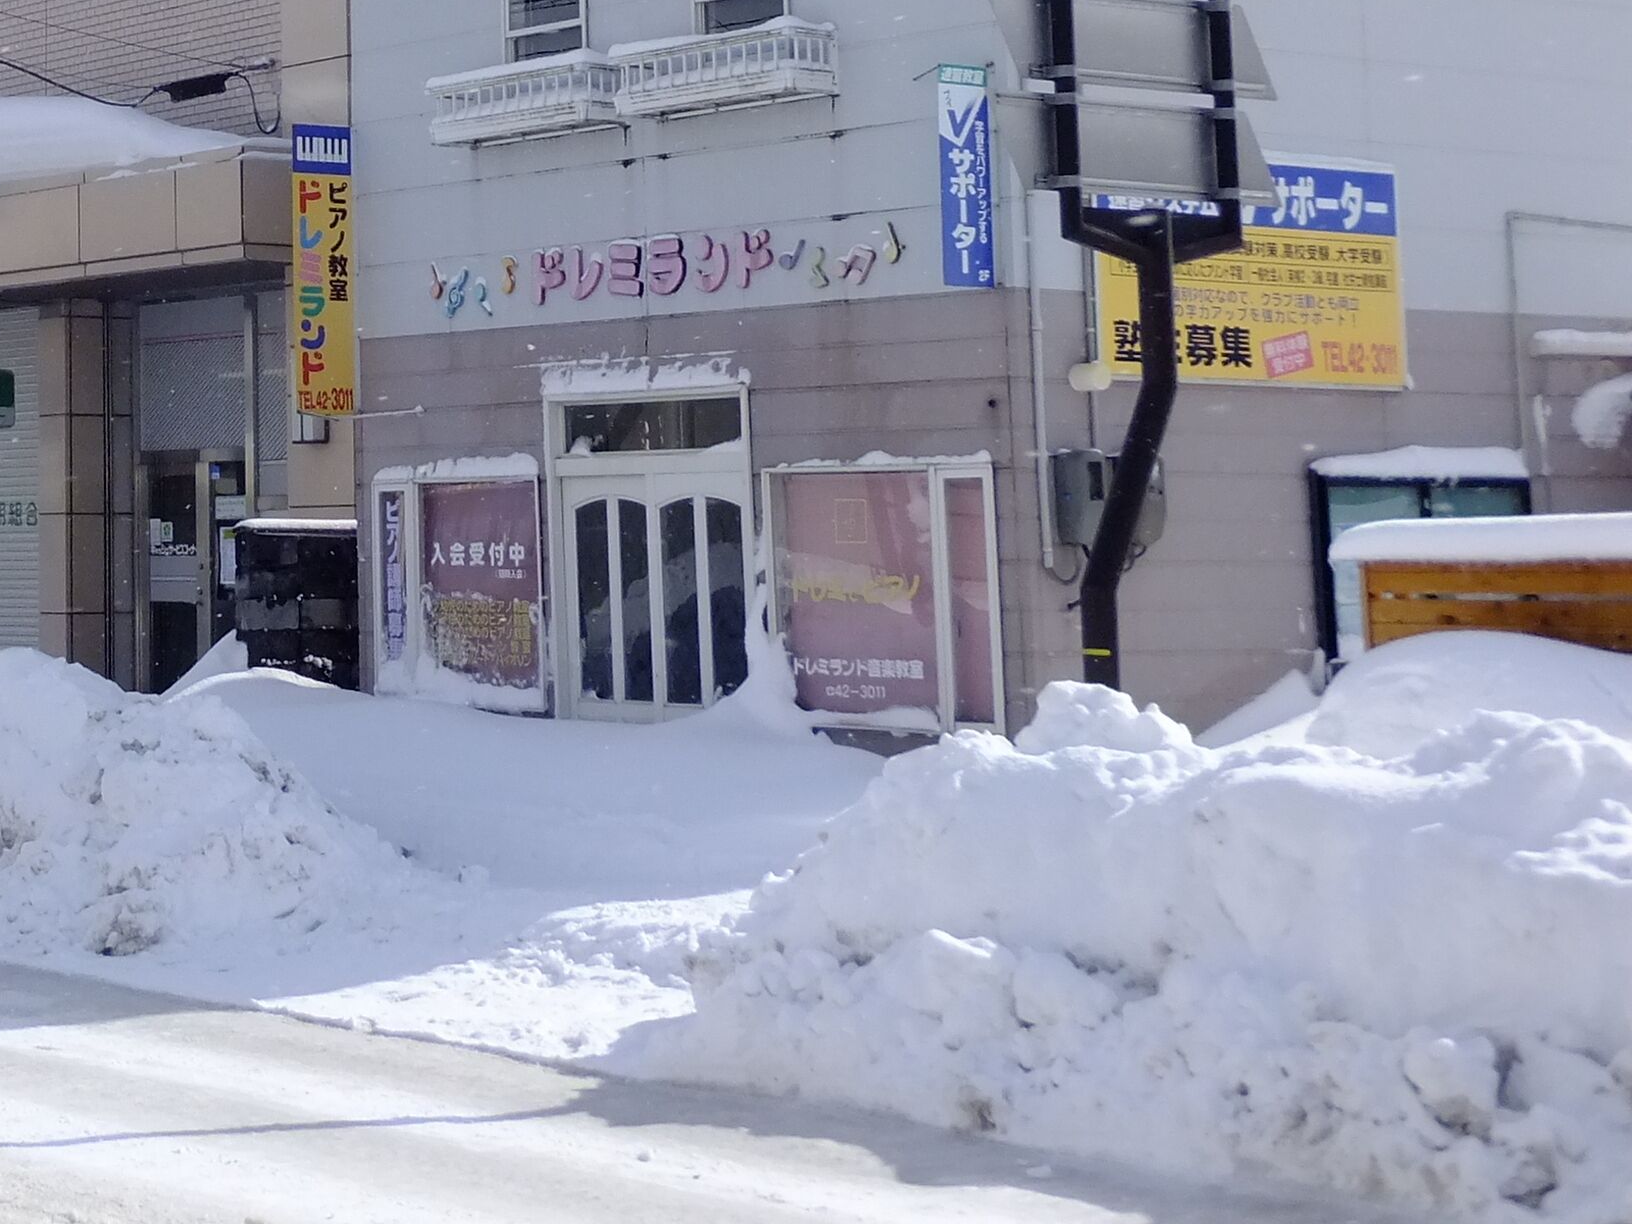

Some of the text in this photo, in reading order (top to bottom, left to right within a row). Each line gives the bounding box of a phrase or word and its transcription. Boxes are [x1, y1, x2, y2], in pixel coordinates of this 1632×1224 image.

[1242, 176, 1389, 230] サポーター
[328, 181, 349, 302] ピアノ教室
[531, 227, 774, 306] ドレミランド
[299, 179, 326, 386] ドレミランド
[1113, 319, 1253, 368] 塾募集
[430, 542, 526, 567] 入会受付中
[793, 657, 925, 679] ドレミランド音楽教室
